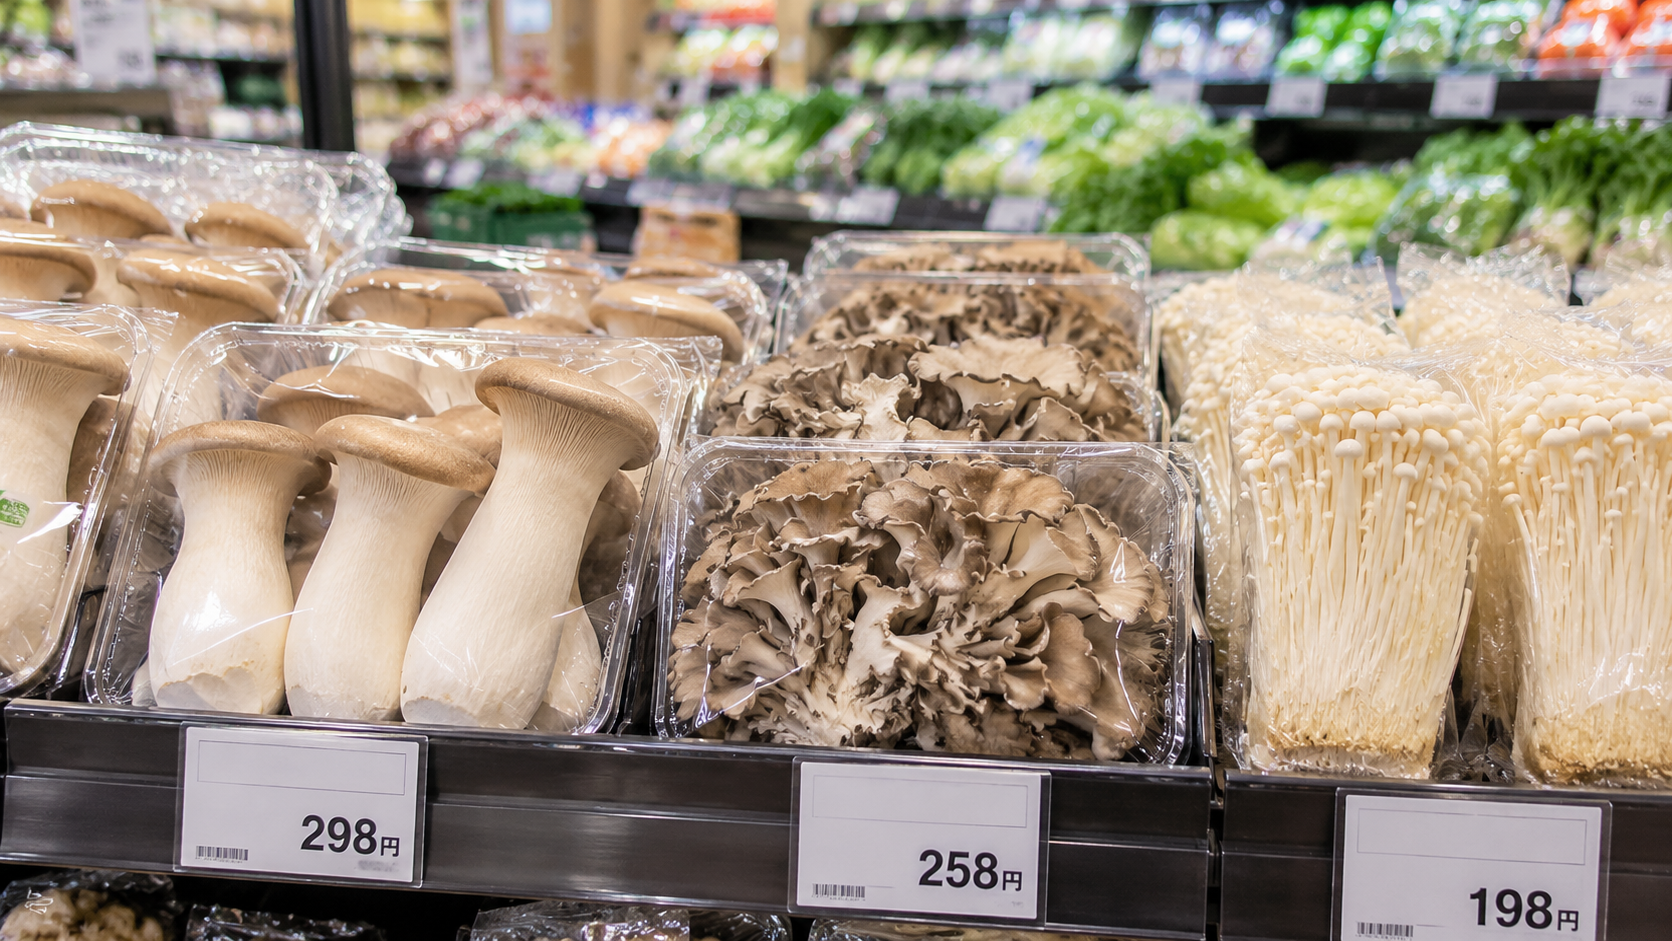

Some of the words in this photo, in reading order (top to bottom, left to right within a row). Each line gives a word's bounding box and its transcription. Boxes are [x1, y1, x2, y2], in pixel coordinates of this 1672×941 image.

[301, 815, 399, 857] 298円
[919, 849, 1022, 891] 258円
[1469, 887, 1578, 931] 198円
